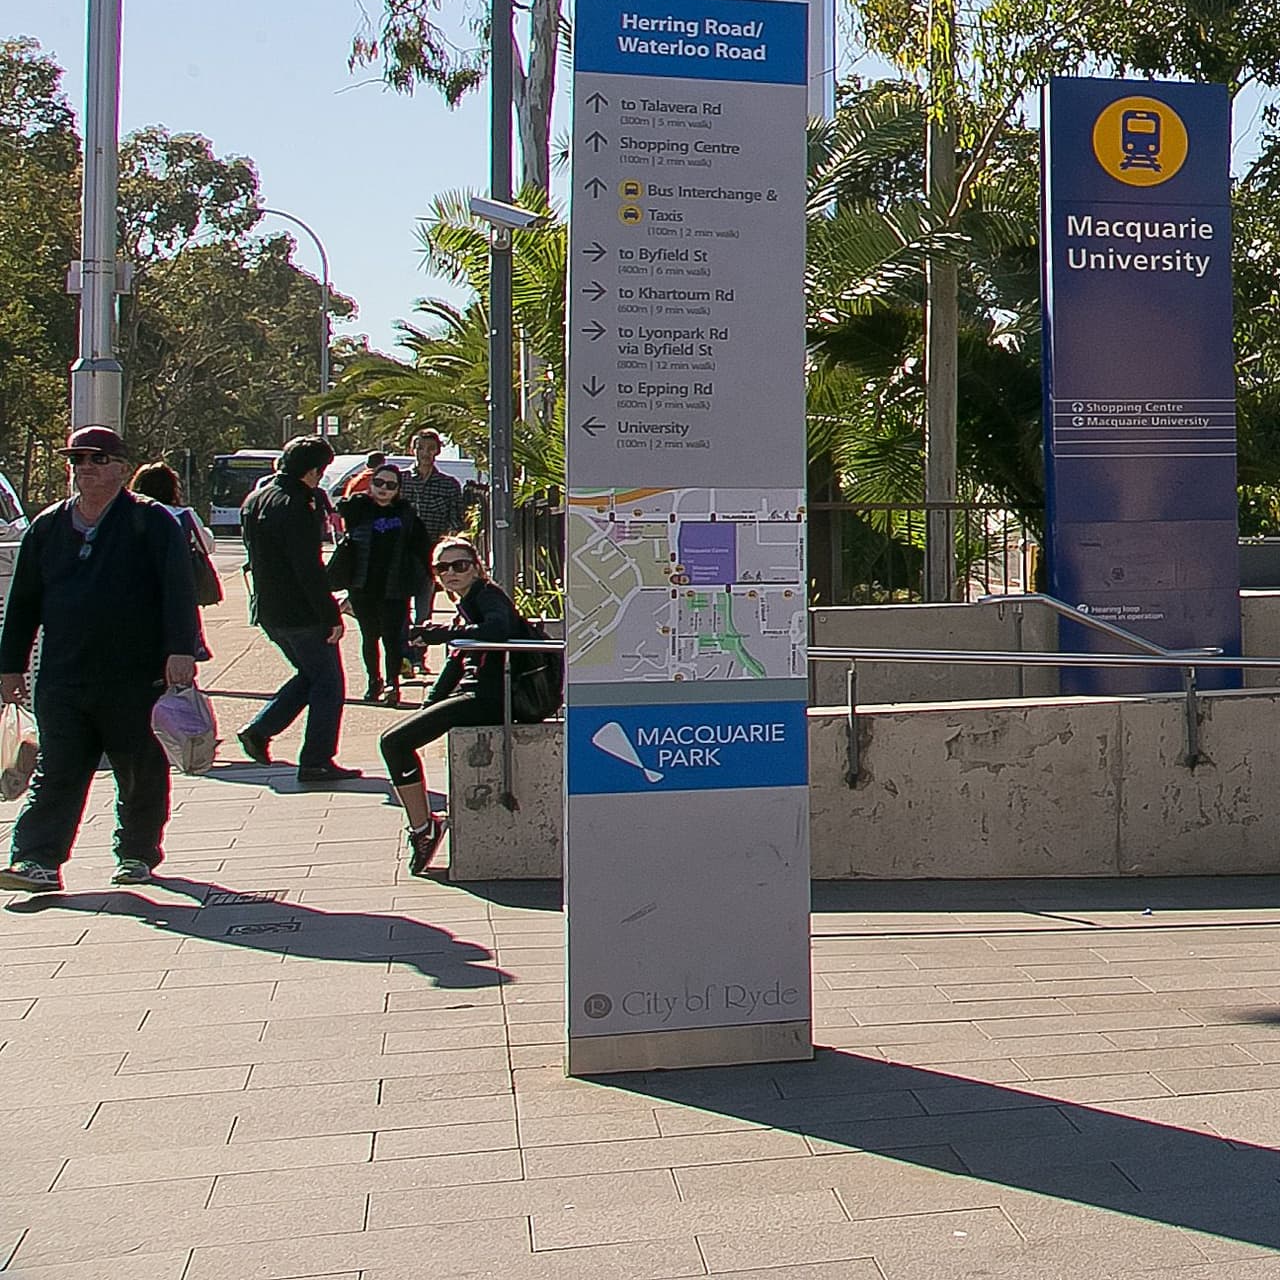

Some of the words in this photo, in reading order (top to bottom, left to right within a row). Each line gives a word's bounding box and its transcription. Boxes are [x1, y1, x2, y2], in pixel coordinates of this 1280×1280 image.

[622, 13, 699, 37] Herring
[705, 19, 764, 38] Road/
[618, 36, 710, 57] Waterloo
[715, 42, 766, 61] Road
[621, 99, 636, 110] to
[639, 99, 698, 114] Talavera
[702, 103, 721, 115] Rd
[620, 136, 689, 155] Shopping
[694, 140, 740, 154] Centre
[648, 184, 673, 197] Bus
[679, 186, 762, 203] Interchange
[766, 189, 778, 201] &
[648, 208, 683, 222] Taxis
[1067, 215, 1214, 243] Macquarie
[619, 249, 634, 259] to
[639, 248, 689, 263] Byfield
[694, 249, 708, 262] St
[1068, 248, 1211, 278] University
[619, 287, 634, 299] to
[639, 287, 710, 300] Khartoum
[715, 289, 734, 301] Rd
[618, 327, 633, 338] to
[638, 326, 705, 341] Lyonpark
[709, 328, 728, 340] Rd
[618, 342, 639, 354] via
[644, 343, 694, 358] Byfield
[699, 344, 713, 356] St
[617, 383, 633, 394] to
[638, 382, 689, 398] Epping
[694, 383, 713, 395] Rd
[1086, 402, 1142, 413] Shopping
[1145, 402, 1183, 412] Centre
[618, 421, 689, 437] University
[1087, 416, 1148, 427] Macquarie
[1151, 416, 1210, 428] University
[637, 723, 785, 746] MACQUARIE
[658, 748, 721, 768] PARK
[622, 991, 678, 1022] City
[724, 980, 798, 1016] Ryde
